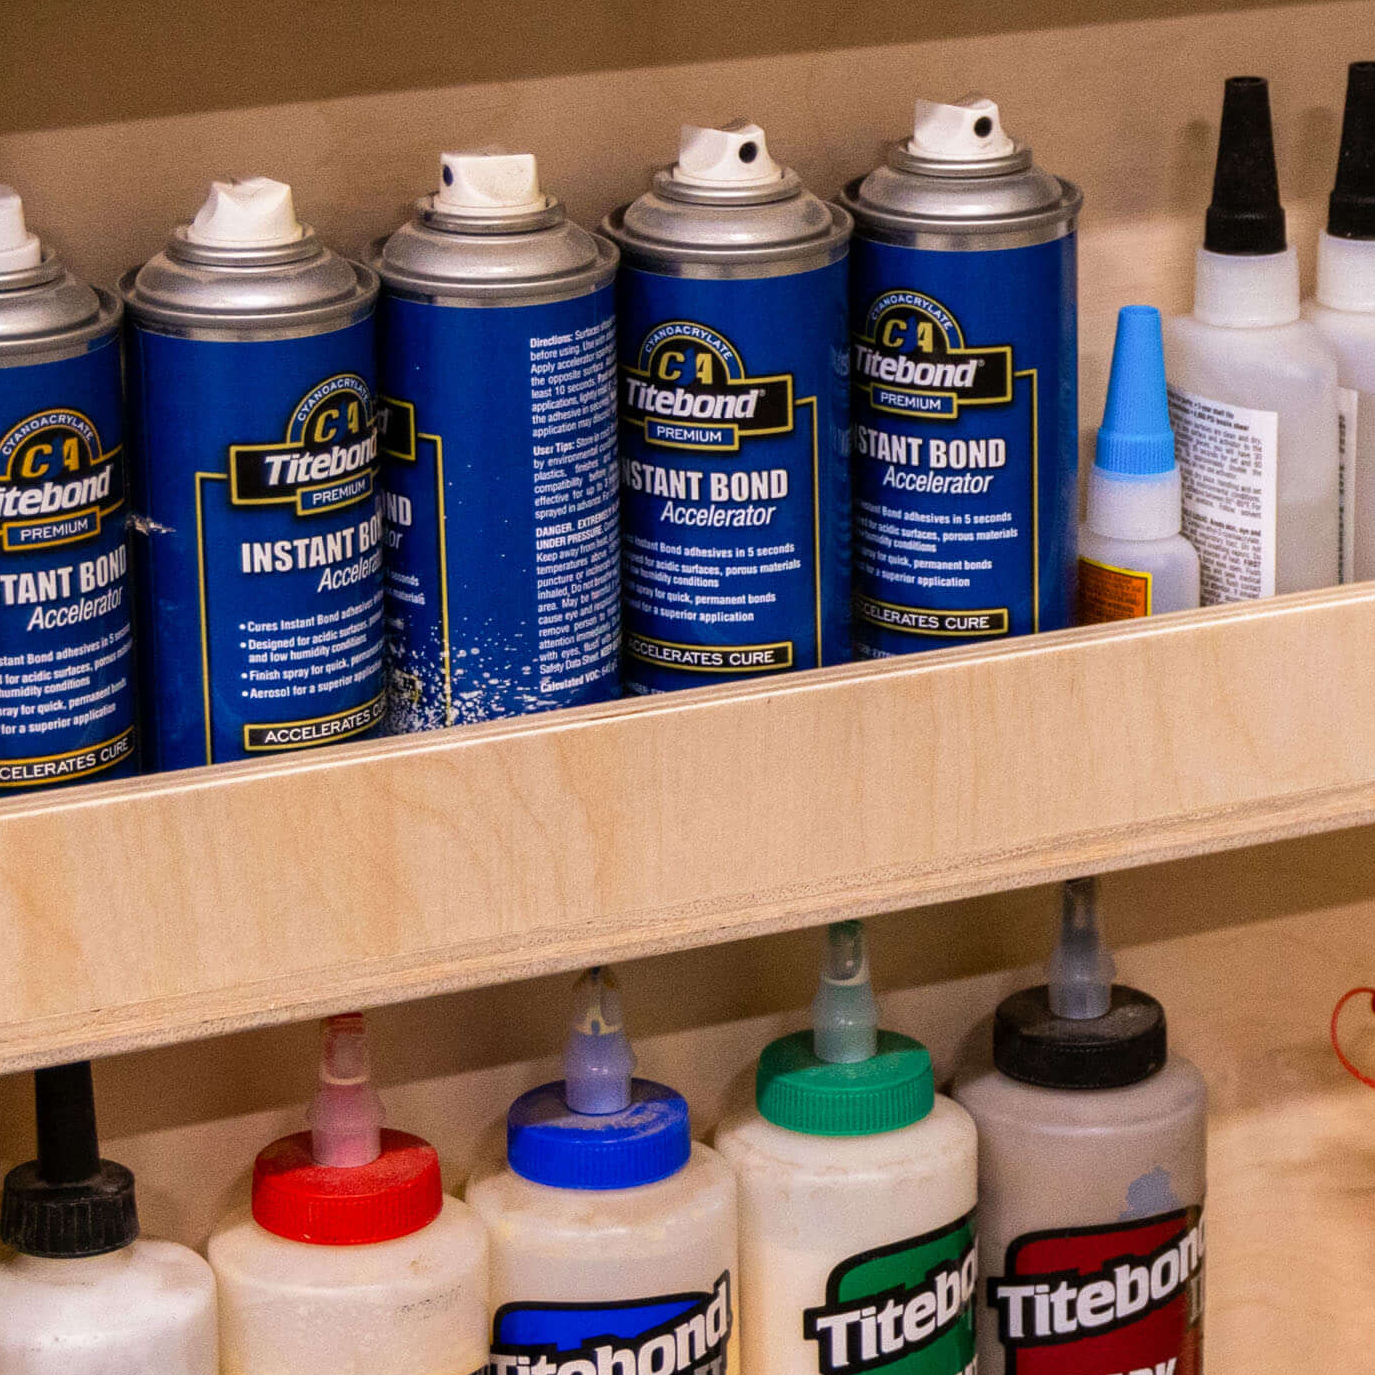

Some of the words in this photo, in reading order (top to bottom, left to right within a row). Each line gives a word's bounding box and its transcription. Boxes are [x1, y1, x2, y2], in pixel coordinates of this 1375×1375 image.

[855, 344, 978, 387] Titebond
[626, 378, 759, 419] Titebond
[880, 392, 941, 410] PREMIUM
[2, 414, 94, 455] CYANOACRYLATE
[657, 426, 721, 442] PREMIUM
[929, 438, 1006, 468] BOND
[710, 470, 788, 502] BOND
[883, 465, 994, 493] Accelerator
[313, 479, 366, 505] PREMIUM
[661, 501, 776, 526] Accelerator
[20, 519, 88, 541] PREMIUM
[943, 532, 974, 542] porous
[977, 528, 1018, 541] materials
[242, 527, 354, 573] INSTANT
[735, 548, 745, 557] in
[748, 547, 754, 557] 5
[757, 543, 794, 556] seconds
[80, 544, 126, 593] BOND
[726, 566, 757, 576] porous
[760, 559, 801, 573] materials
[28, 586, 123, 631] Accelerator
[748, 593, 776, 604] bonds
[247, 622, 278, 632] Cures
[281, 616, 315, 630] Instant
[317, 611, 339, 625] Bond
[945, 617, 990, 629] CURE
[27, 652, 53, 664] Bond
[729, 651, 774, 665] CURE
[265, 709, 370, 743] ACCELERATES
[100, 737, 128, 761] CURE
